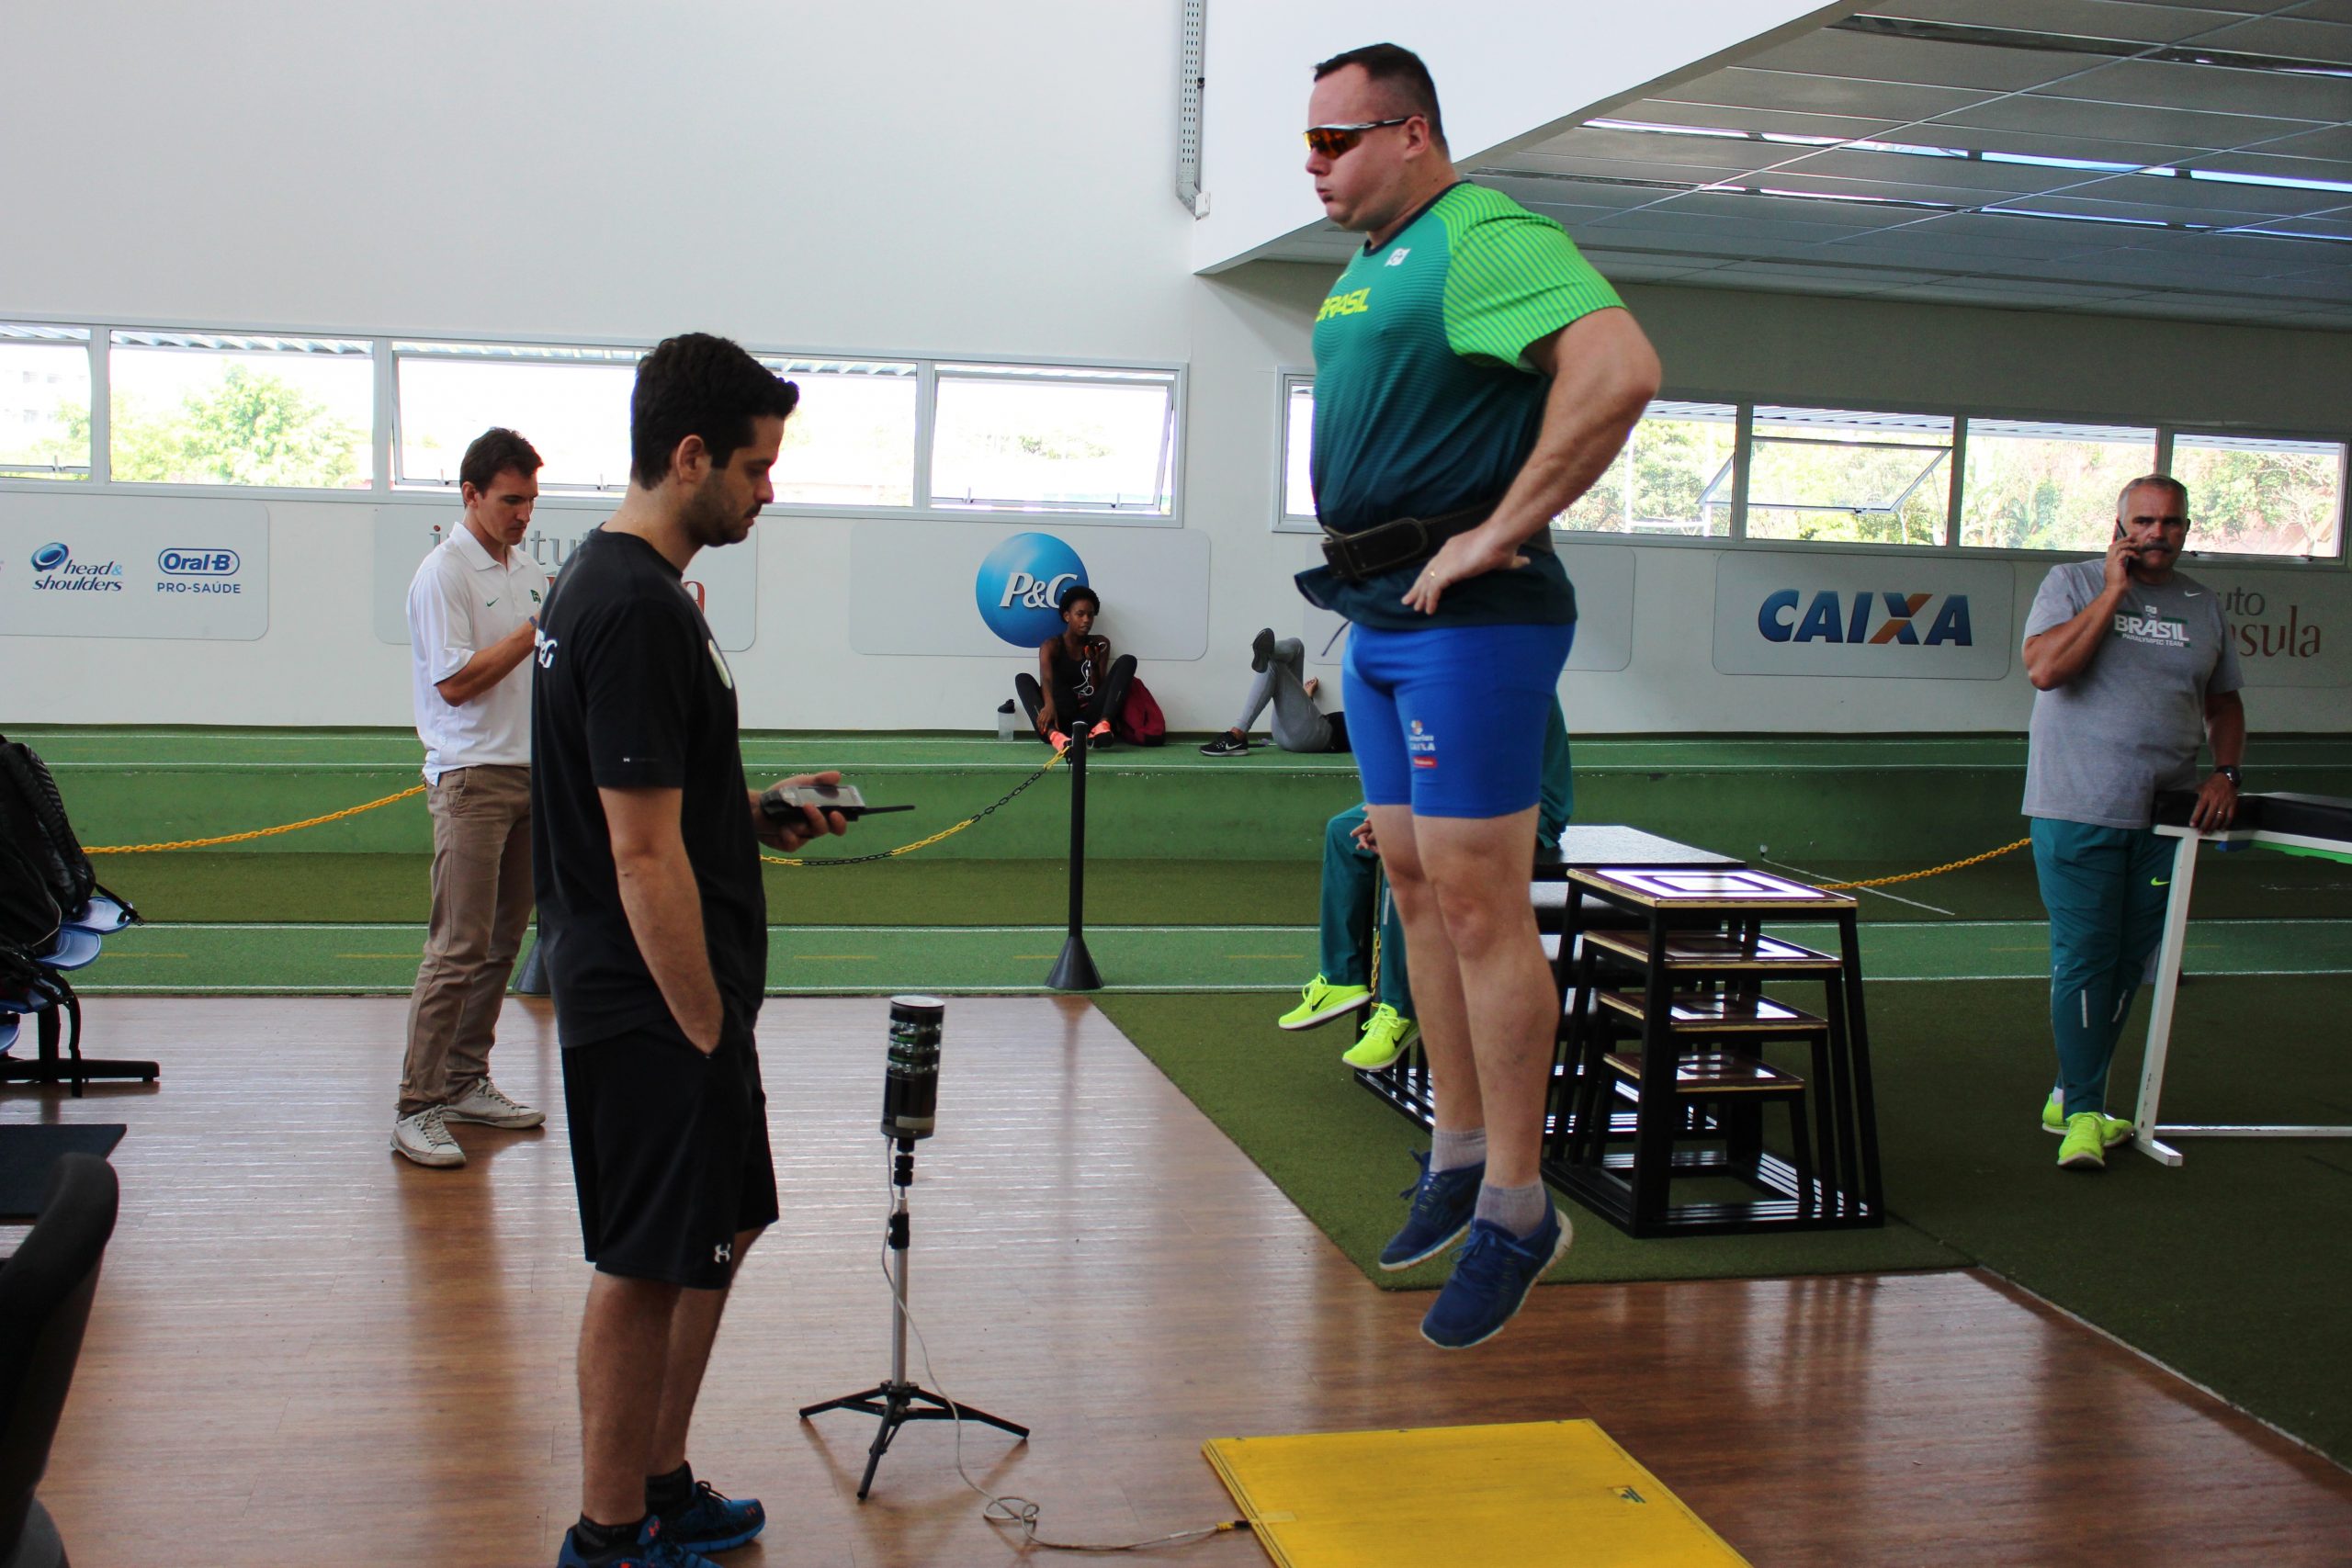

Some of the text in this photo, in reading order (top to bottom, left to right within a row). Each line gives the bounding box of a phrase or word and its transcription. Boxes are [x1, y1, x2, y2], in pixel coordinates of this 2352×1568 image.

[164, 553, 231, 571] Oral-B
[33, 575, 123, 592] shoulders
[157, 581, 242, 594] PRO-SAÚDE
[1758, 588, 1973, 647] CAIXA
[2114, 614, 2190, 641] BRASIL
[2165, 639, 2185, 648] TEAM
